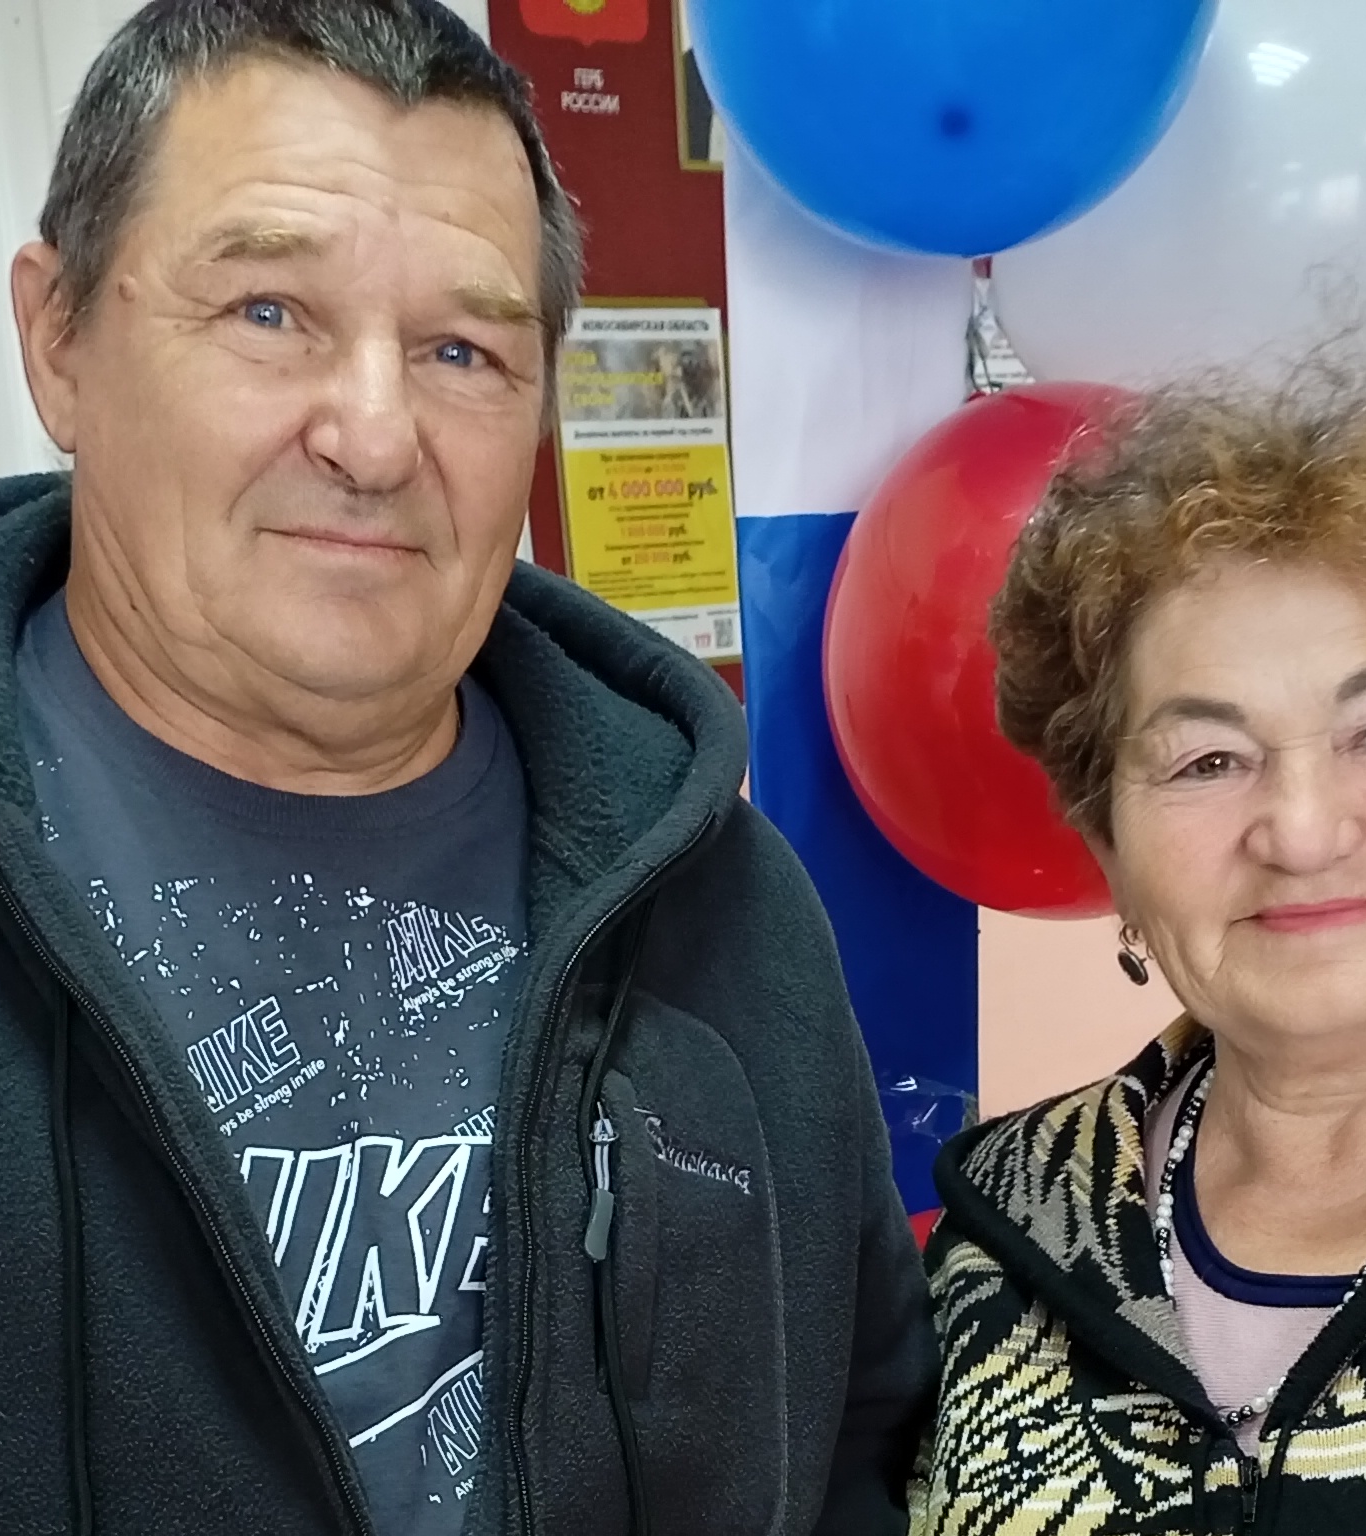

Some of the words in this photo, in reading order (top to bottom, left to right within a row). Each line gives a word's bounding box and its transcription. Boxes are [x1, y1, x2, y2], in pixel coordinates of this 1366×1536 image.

[588, 486, 605, 501] от
[621, 480, 650, 498] 000
[654, 478, 685, 497] 000
[688, 478, 718, 500] руб.
[438, 977, 457, 991] be
[456, 956, 495, 982] strong
[236, 1108, 255, 1124] be
[254, 1084, 293, 1114] strong
[289, 1075, 305, 1090] in
[303, 1058, 327, 1081] life
